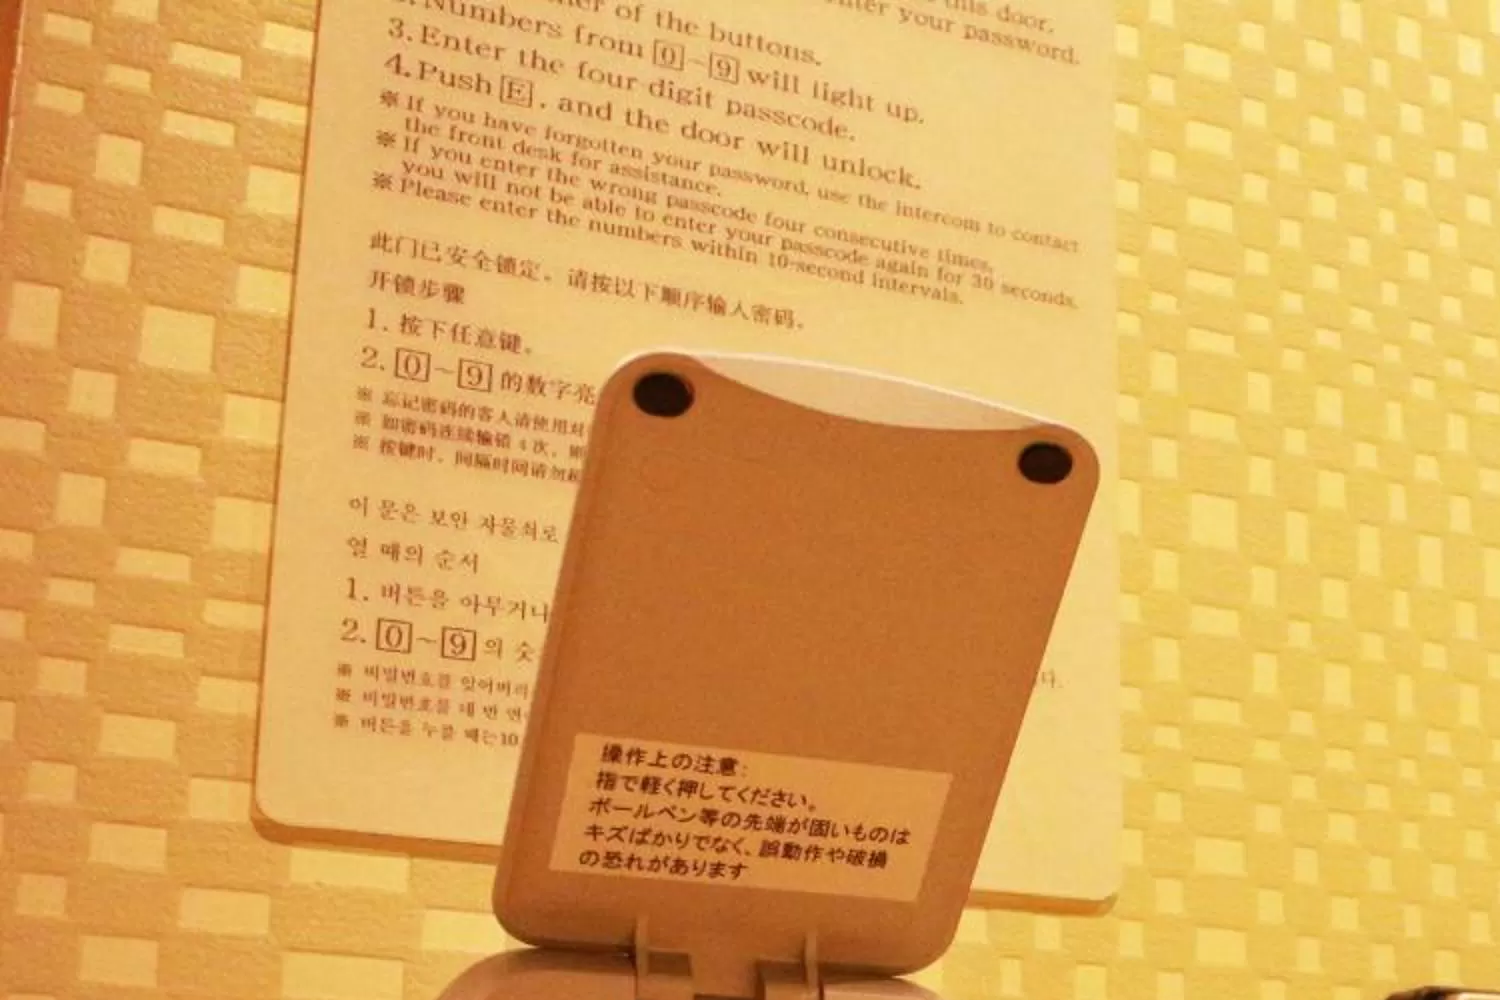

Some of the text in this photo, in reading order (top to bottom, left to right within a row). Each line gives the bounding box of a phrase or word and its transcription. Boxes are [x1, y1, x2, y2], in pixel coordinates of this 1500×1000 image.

[575, 23, 645, 59] from
[747, 67, 800, 95] will
[812, 79, 874, 113] light
[886, 100, 925, 125] up.
[615, 3, 644, 24] of
[655, 10, 699, 36] the
[709, 21, 822, 66] buttons.
[825, 0, 1081, 65] nter your password.
[518, 48, 565, 75] the
[577, 60, 639, 92] four
[648, 77, 714, 110] digit
[725, 98, 856, 142] passcode.
[404, 117, 722, 198] the front desk for assistance.
[406, 94, 424, 113] If
[434, 103, 476, 126] you
[483, 111, 537, 137] have
[544, 124, 643, 160] forgotten
[651, 149, 702, 173] your
[816, 186, 850, 205] use
[857, 193, 888, 212] the
[895, 200, 981, 233] intercom
[987, 220, 1006, 238] to
[1010, 228, 1080, 254] contact
[557, 96, 613, 122] and
[625, 107, 669, 134] the
[680, 119, 744, 151] door
[756, 140, 810, 166] will
[822, 152, 921, 190] unlock.
[400, 177, 964, 306] Please enter the numbers within 10-second intervals.
[401, 159, 444, 180] you
[453, 169, 498, 192] will
[506, 180, 543, 200] not
[549, 187, 575, 206] be
[581, 195, 628, 219] able
[634, 205, 655, 223] to
[661, 209, 718, 236] enter
[724, 224, 774, 249] your
[780, 234, 869, 267] passcode
[874, 255, 930, 280] again
[935, 265, 964, 287] for
[970, 272, 995, 292] 30
[402, 136, 420, 154] If
[430, 144, 473, 167] you
[479, 156, 540, 179] enter
[547, 167, 582, 188] the
[590, 178, 658, 206] wrong
[666, 193, 758, 225] passcode
[764, 210, 808, 235] four
[812, 224, 930, 260] consecutive
[578, 849, 749, 881] の恐れがあります
